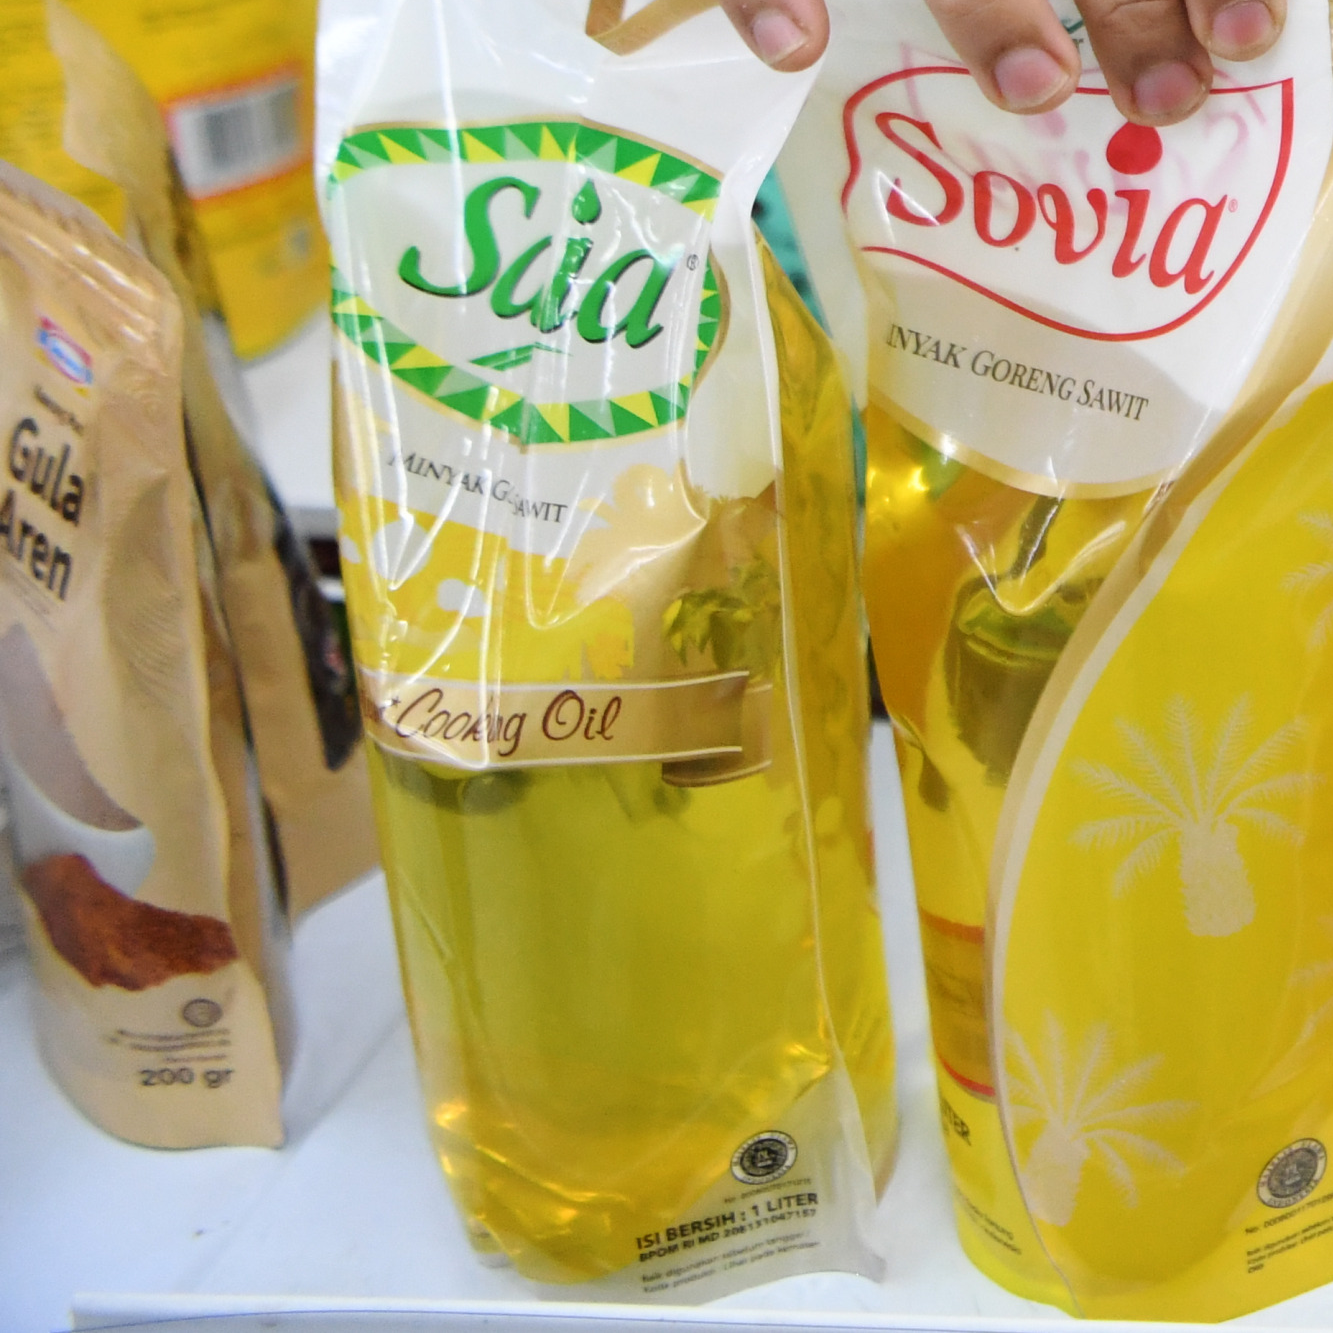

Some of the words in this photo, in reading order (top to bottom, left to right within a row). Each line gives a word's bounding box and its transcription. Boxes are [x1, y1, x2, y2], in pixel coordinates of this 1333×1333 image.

[875, 111, 1228, 295] Sovia
[971, 350, 1077, 402] GORENG
[1076, 379, 1149, 422] SAWIT
[8, 417, 86, 527] Gula
[0, 489, 73, 601] Aren
[542, 689, 623, 742] Oil
[139, 1067, 195, 1086] 200
[635, 1231, 661, 1250] ISI
[666, 1211, 736, 1242] BERSIH
[752, 1204, 760, 1217] 1
[766, 1192, 819, 1213] LITER
[638, 1242, 680, 1263] BPOM
[698, 1231, 720, 1246] MD
